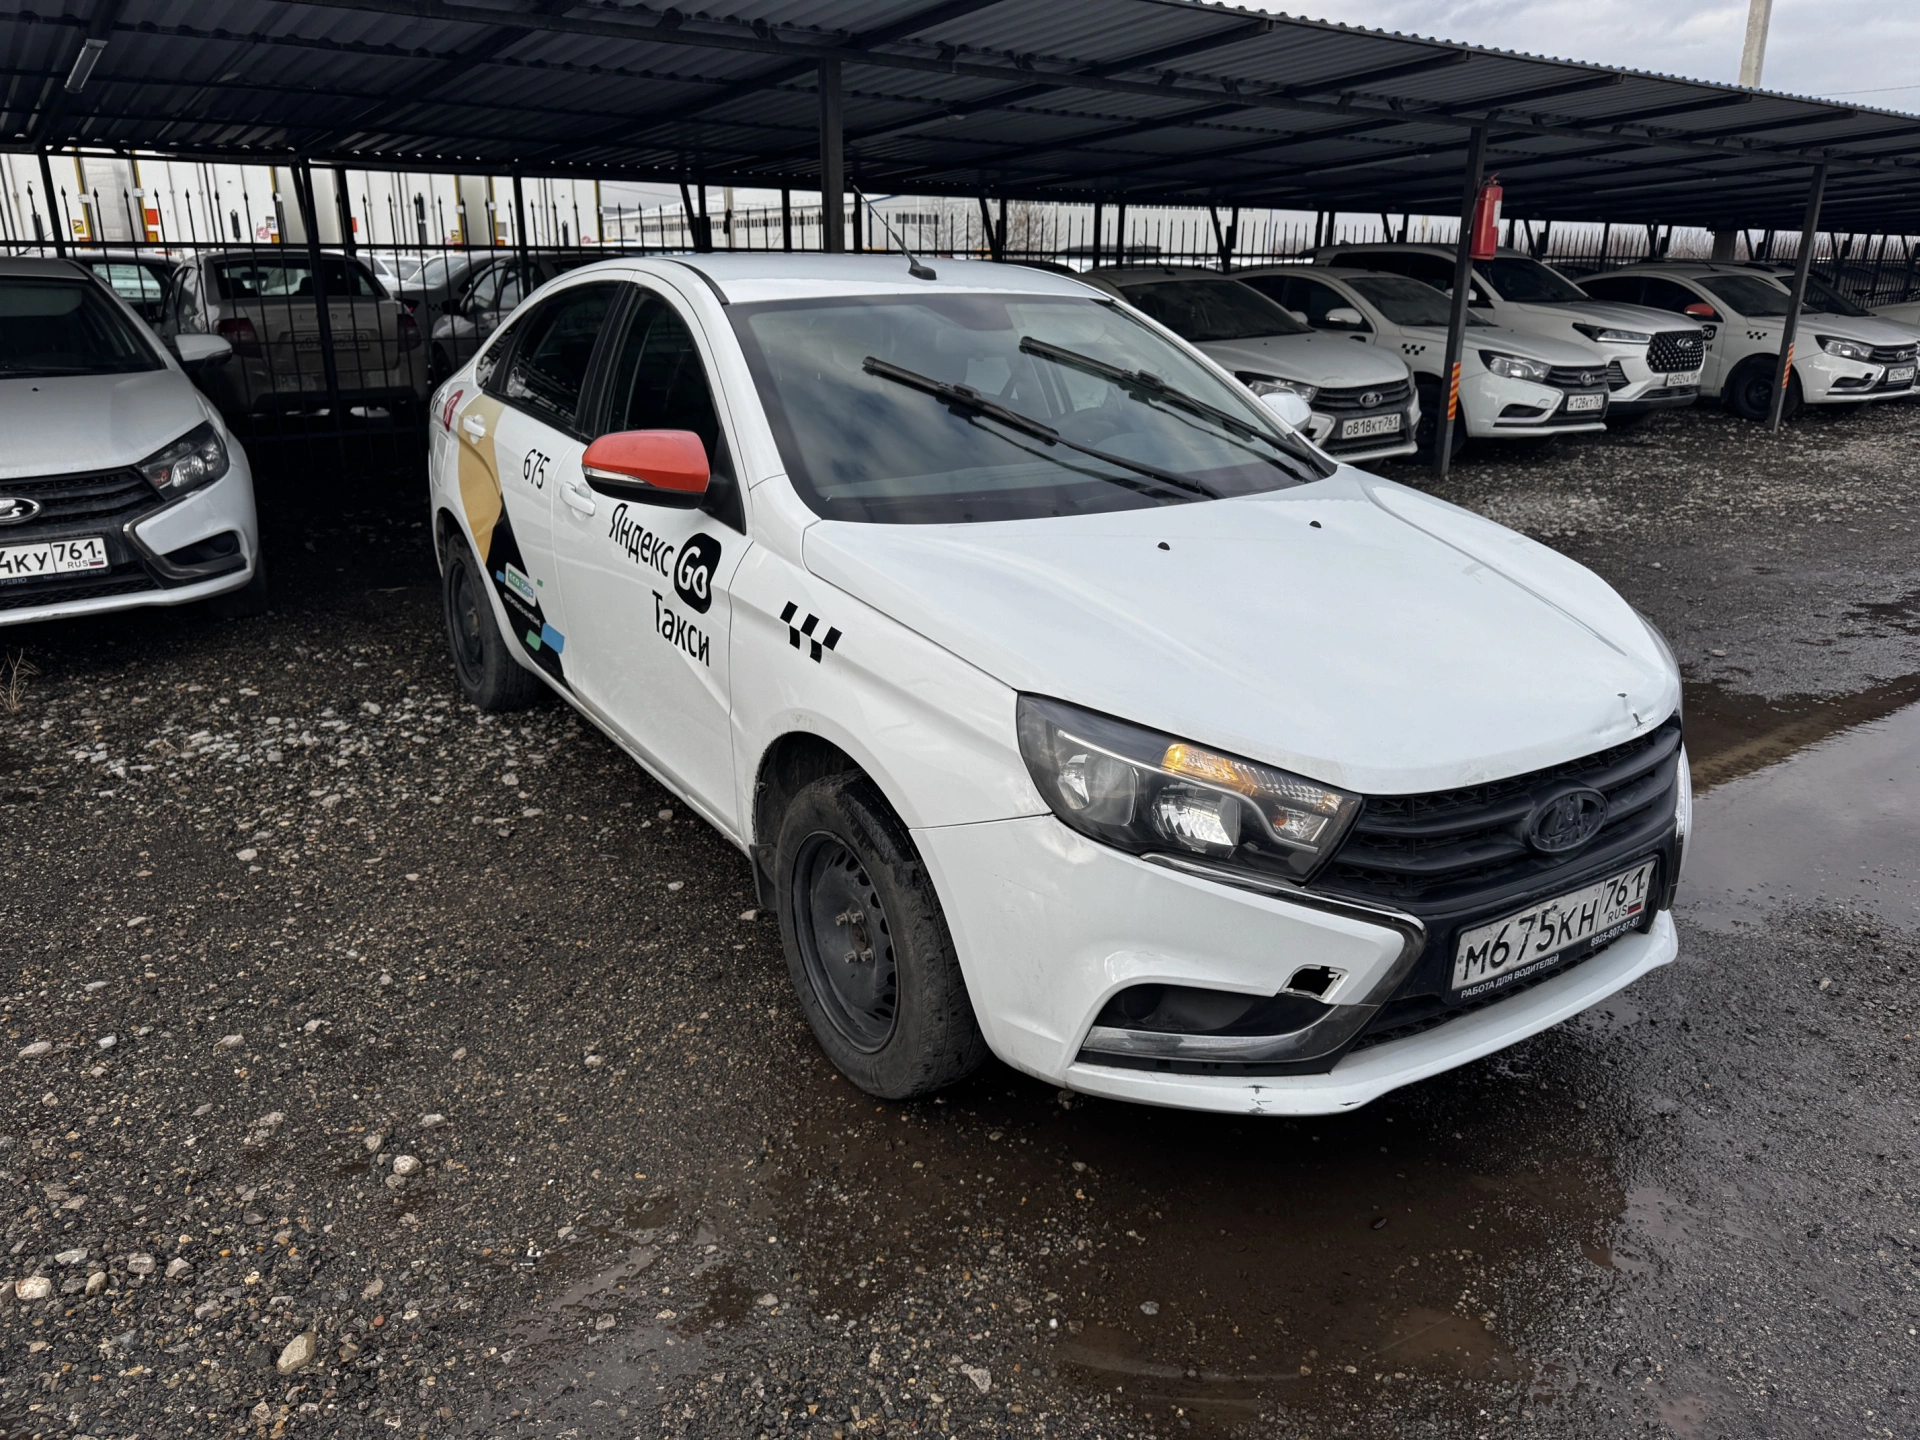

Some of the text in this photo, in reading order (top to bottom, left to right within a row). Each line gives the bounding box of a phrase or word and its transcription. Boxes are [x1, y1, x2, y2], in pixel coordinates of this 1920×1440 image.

[523, 448, 551, 490] 675
[53, 540, 97, 562] 761
[67, 559, 89, 569] RUS
[609, 503, 708, 599] Яндекс Go
[652, 589, 710, 667] Такси
[1604, 867, 1646, 914] 761
[1606, 906, 1628, 924] RUS
[1461, 953, 1560, 999] РАБОТА ДЛЯ ВОДИТЕЛЕЙ
